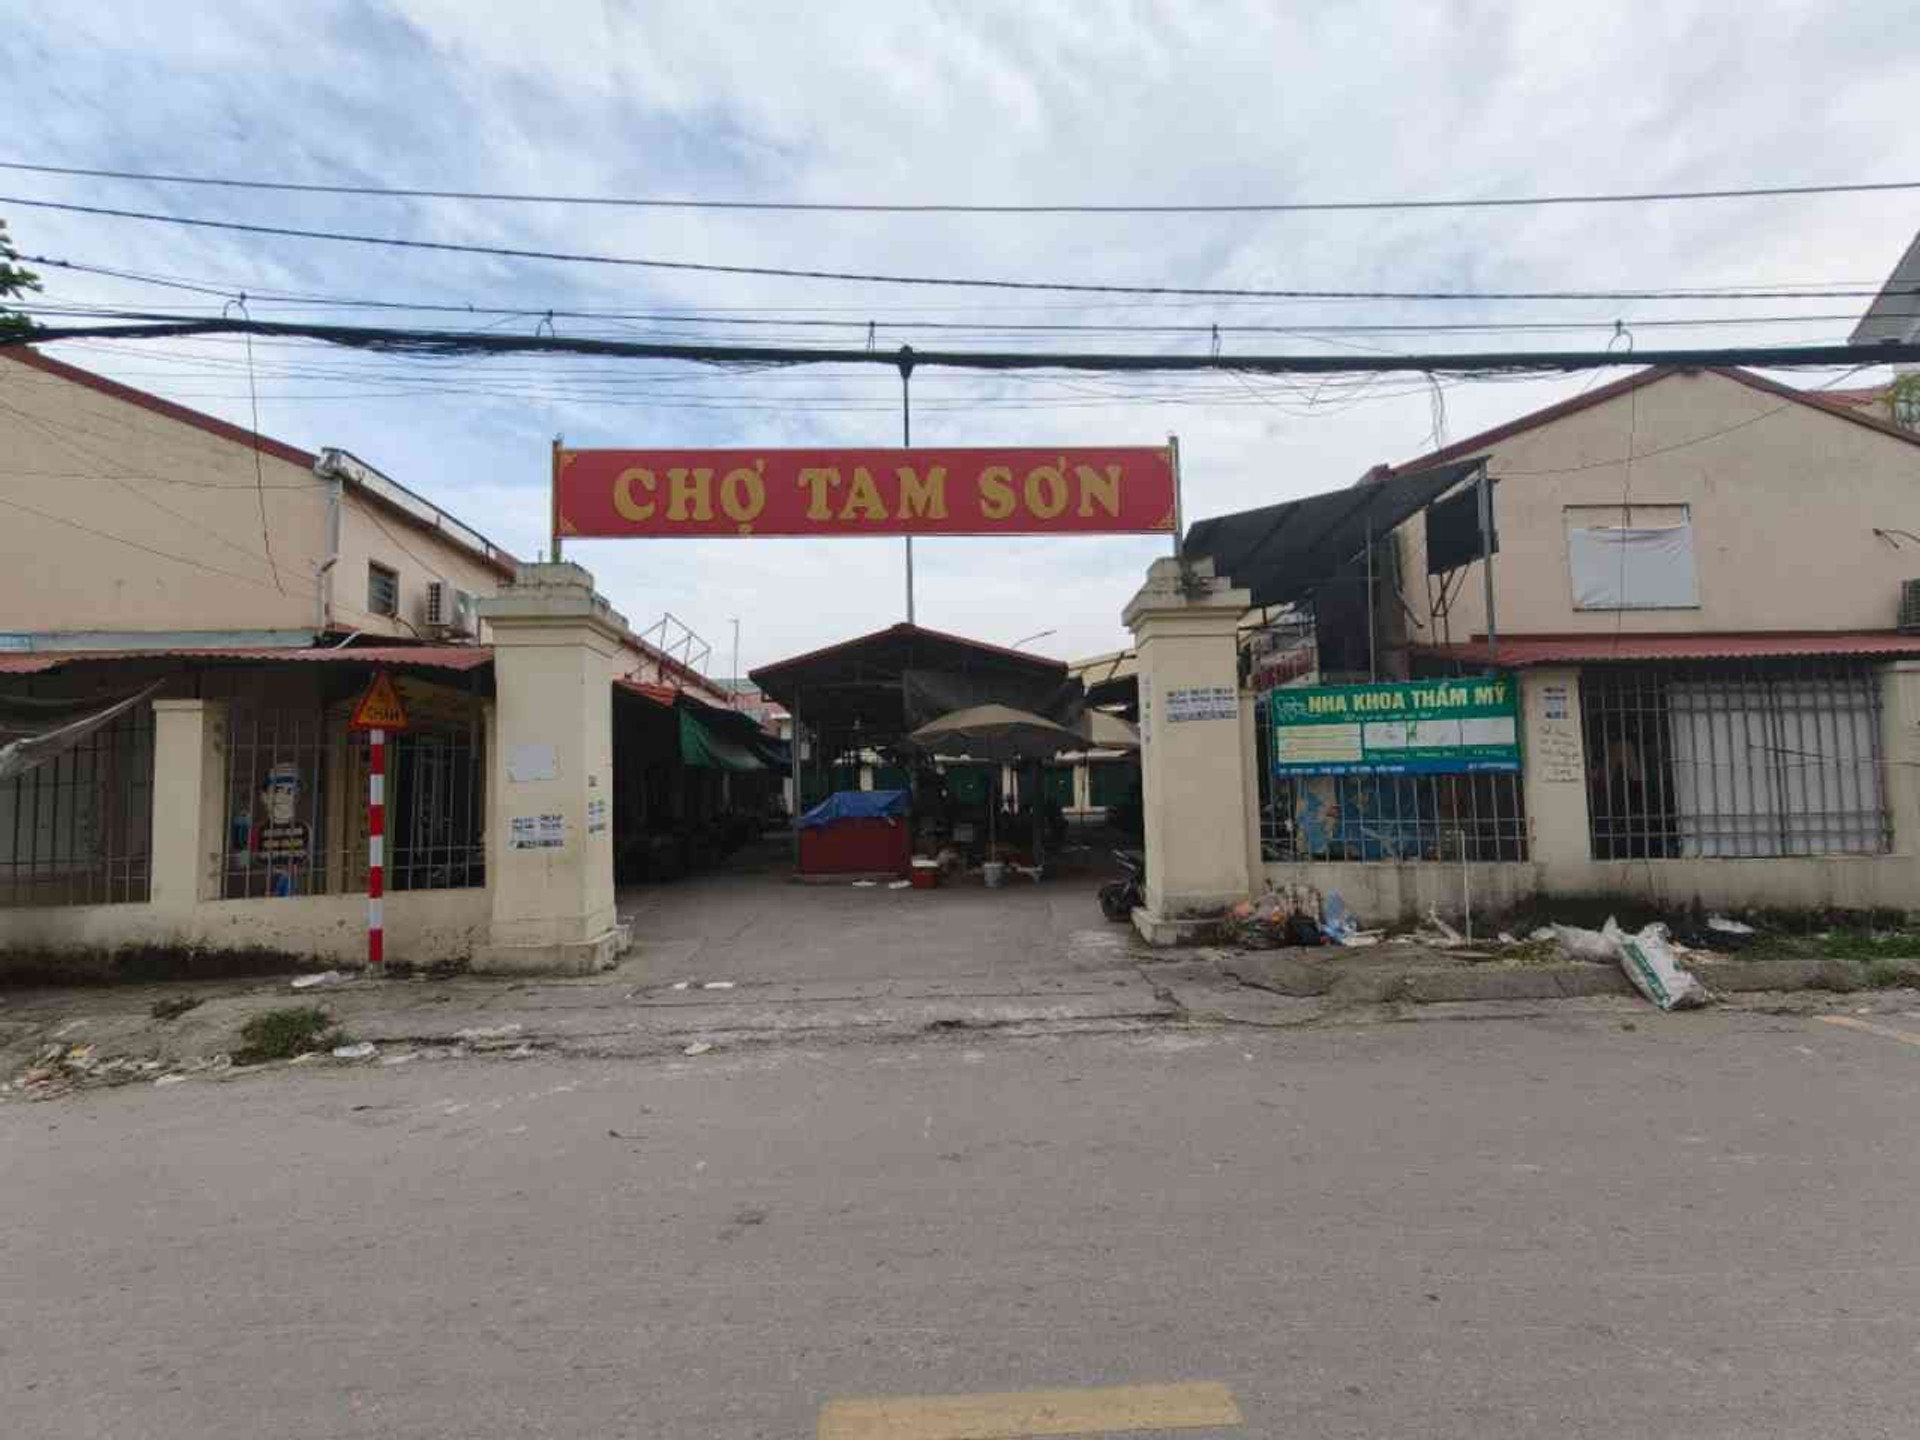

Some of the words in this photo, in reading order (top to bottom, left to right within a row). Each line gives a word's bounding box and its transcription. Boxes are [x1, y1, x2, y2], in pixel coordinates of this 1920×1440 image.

[612, 457, 767, 535] CHỢ
[798, 465, 950, 521] TAM
[978, 455, 1123, 520] SƠN
[1307, 695, 1347, 713] NHA
[1353, 692, 1405, 712] KHOA
